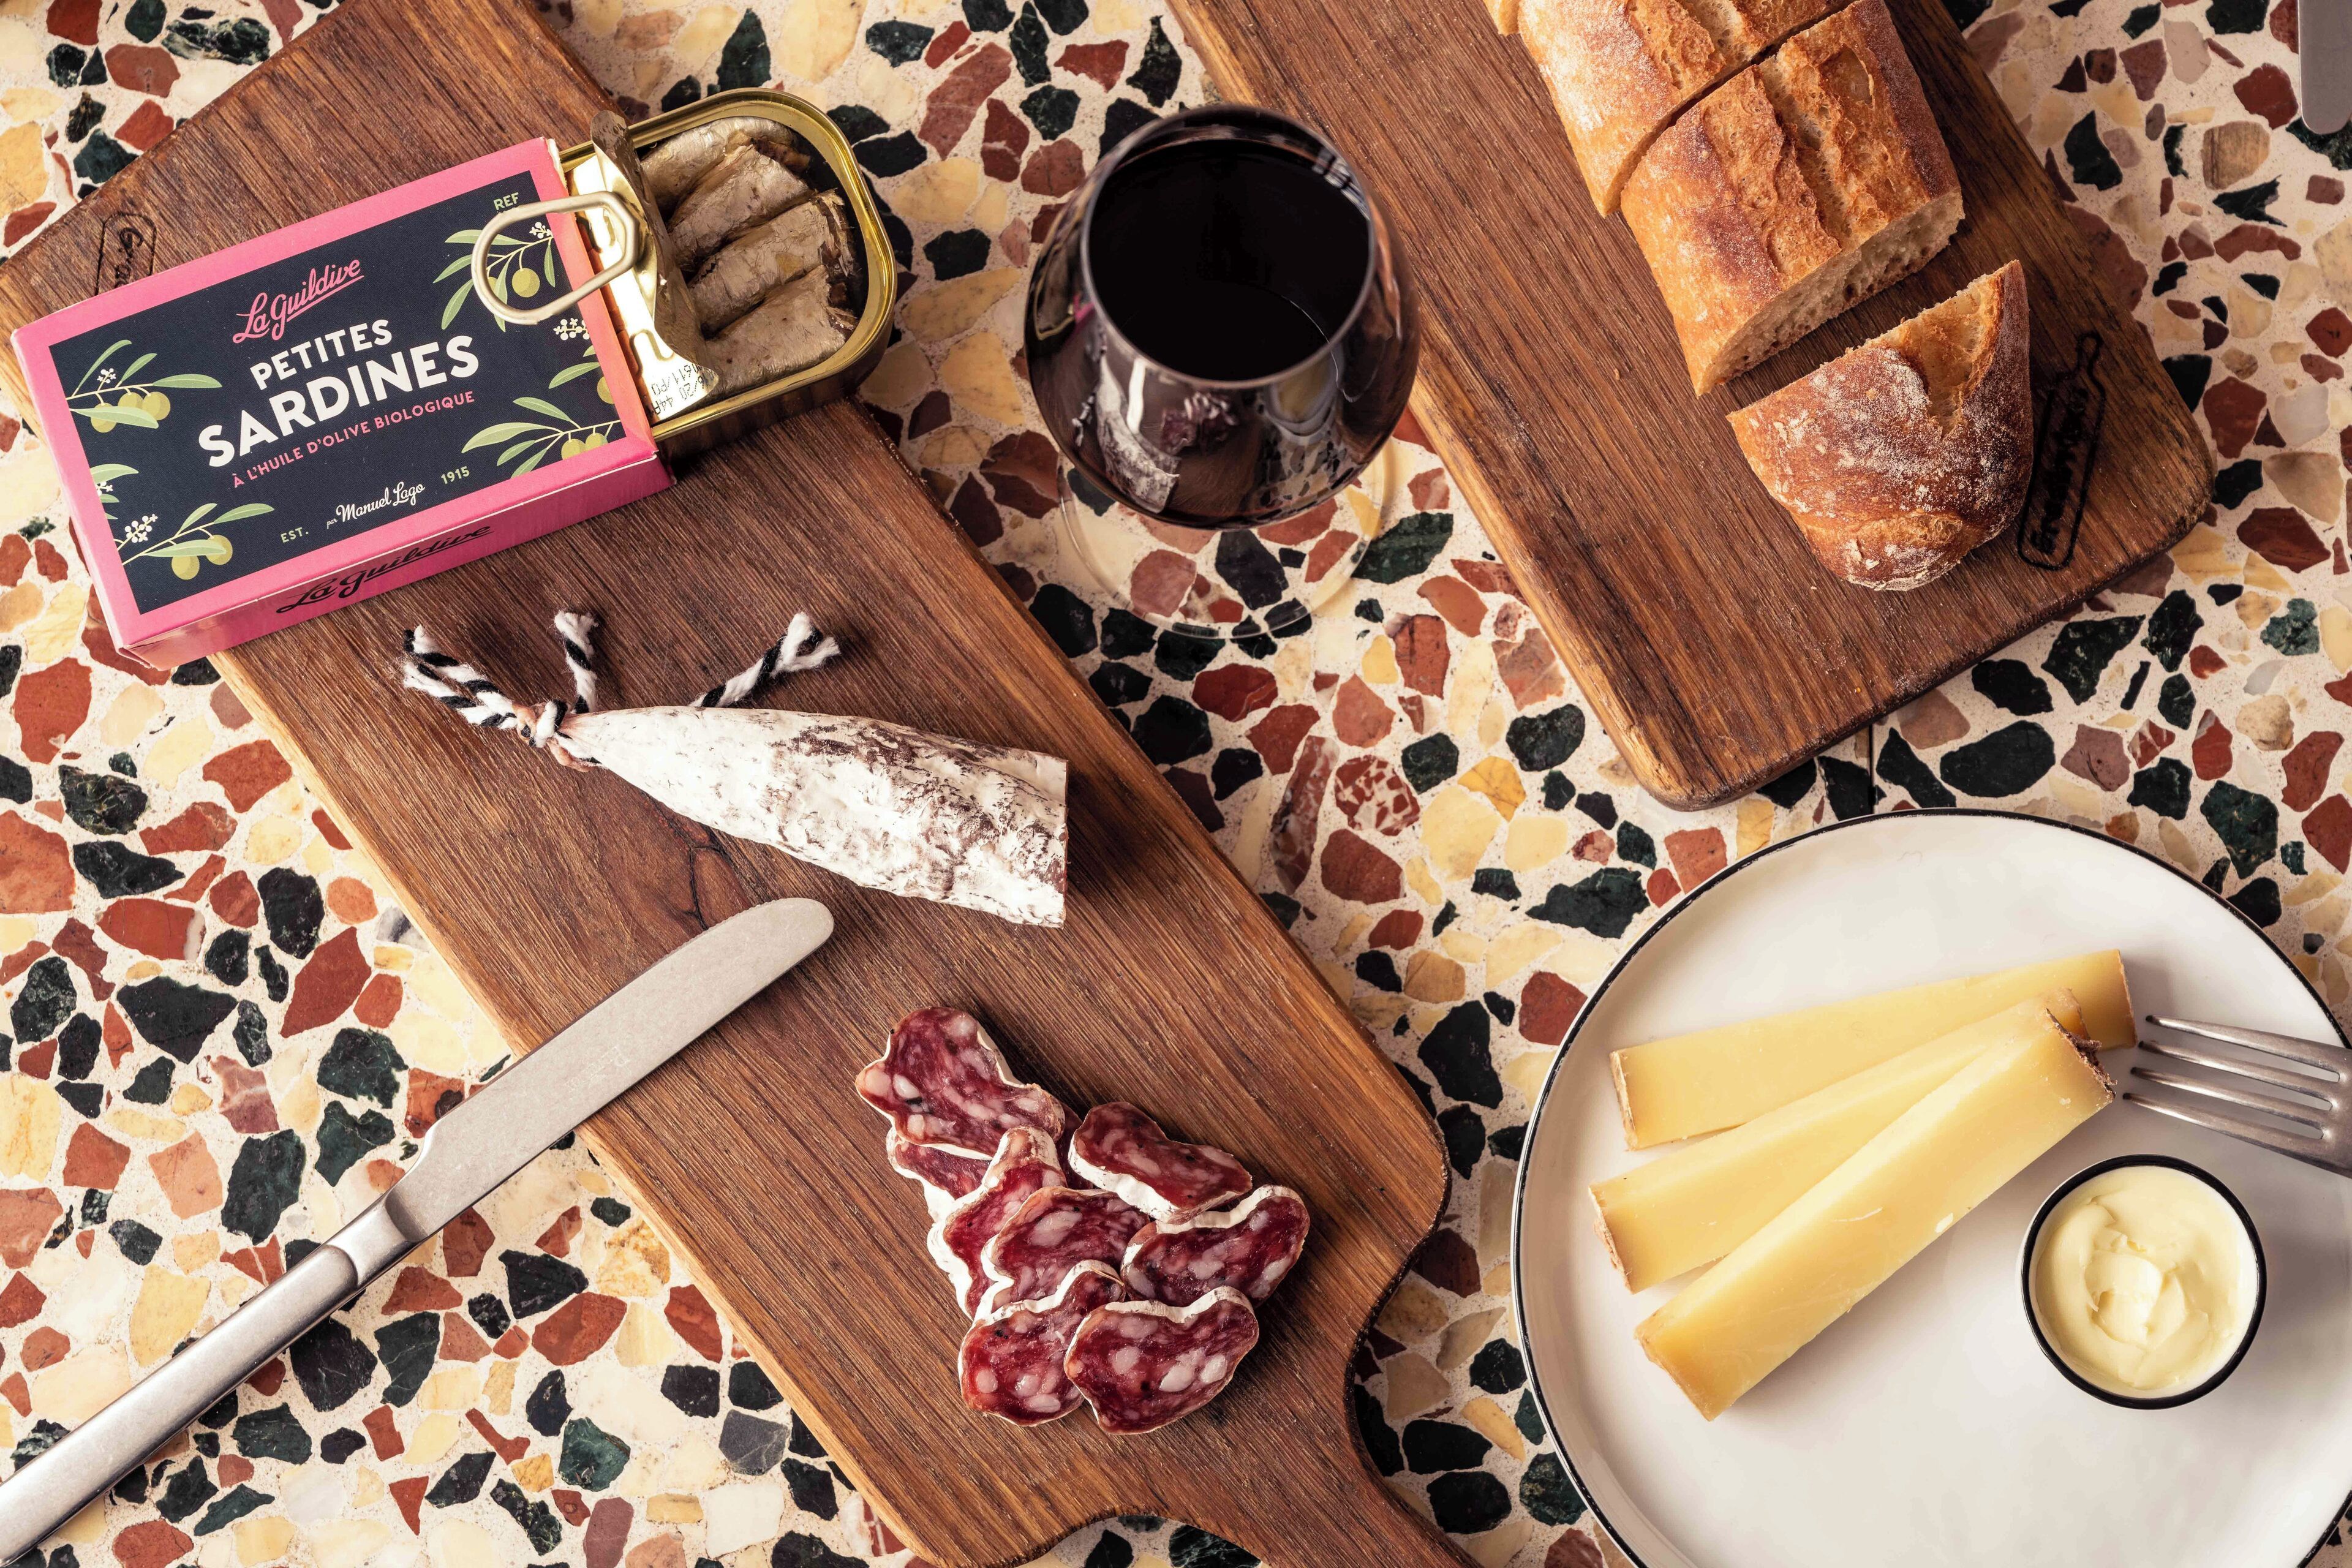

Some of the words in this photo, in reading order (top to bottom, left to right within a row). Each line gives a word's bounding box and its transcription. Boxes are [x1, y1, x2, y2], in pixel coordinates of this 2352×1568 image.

[494, 192, 519, 210] REF
[232, 292, 271, 344] La
[270, 259, 361, 341] Guildive
[250, 319, 392, 390] PETITES
[198, 335, 479, 467] SARDINES
[232, 473, 245, 488] À
[247, 447, 304, 481] L'HUILE
[307, 421, 371, 454] D'OLIVE
[374, 391, 475, 429] BIOLOGIQUE
[281, 527, 309, 543] EST.
[326, 518, 337, 529] par
[336, 487, 392, 522] Manuel
[392, 481, 426, 506] Lago
[441, 466, 470, 484] 1915
[276, 578, 338, 613] La
[338, 526, 493, 598] Guildive
